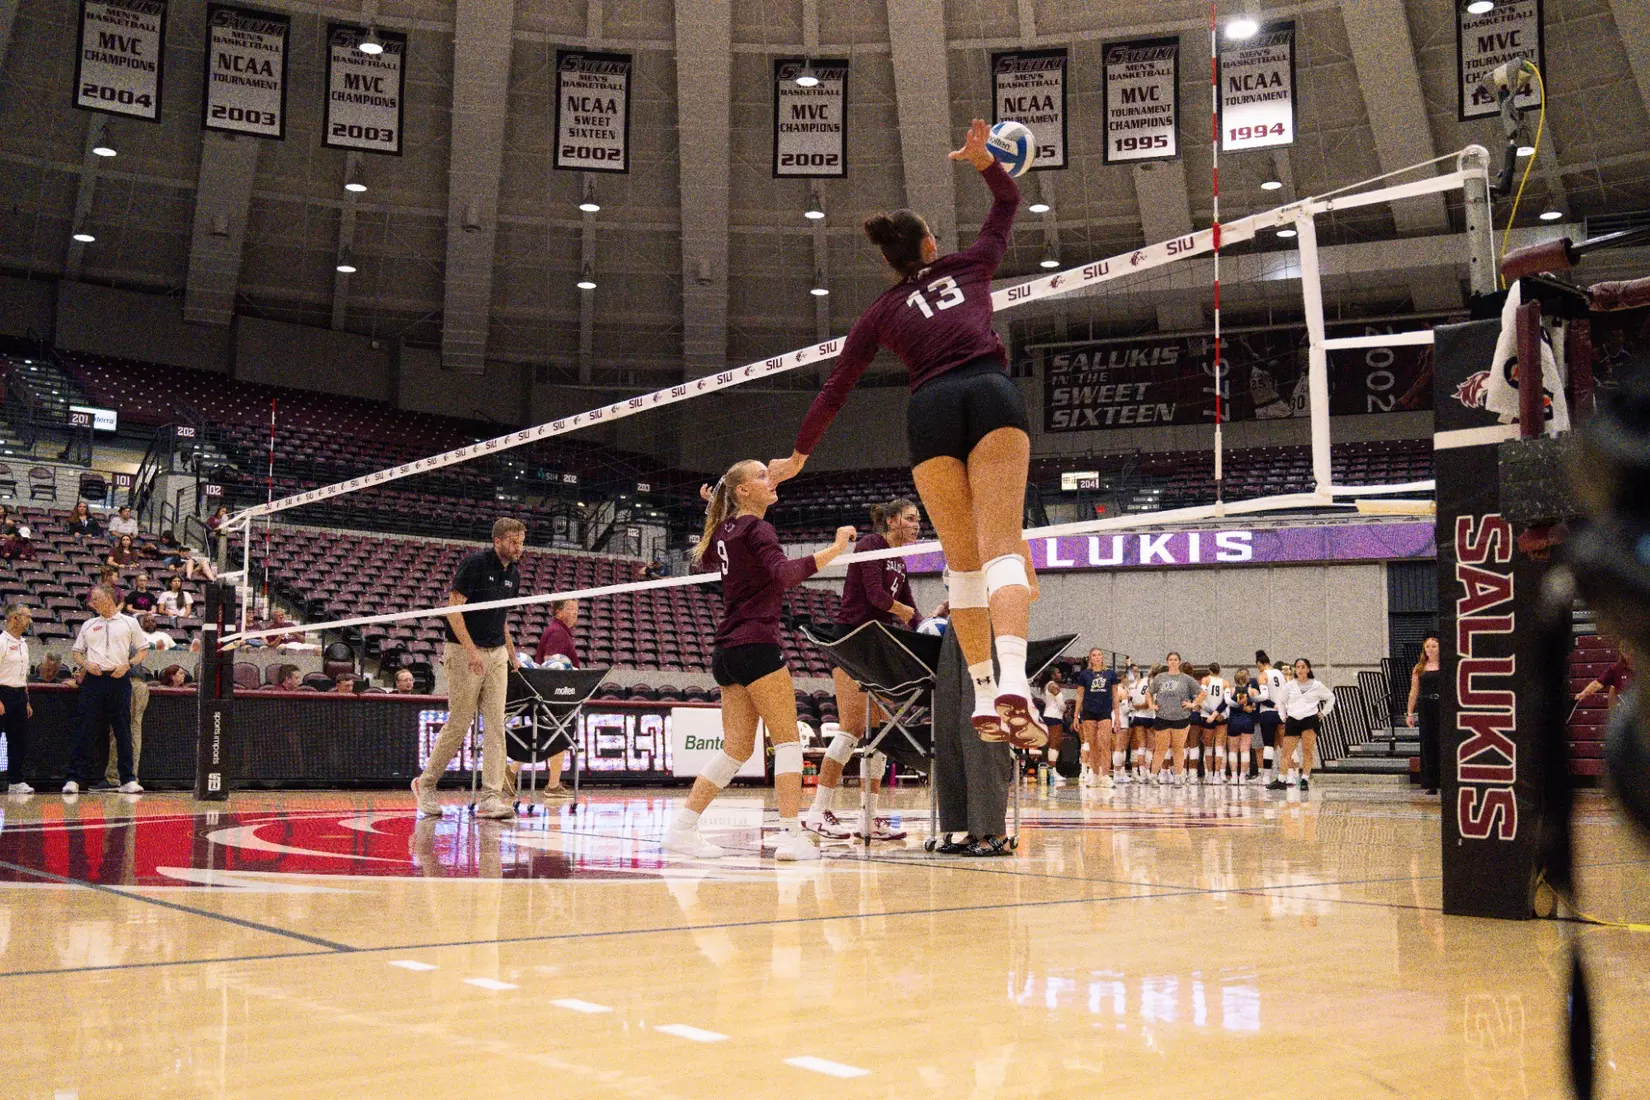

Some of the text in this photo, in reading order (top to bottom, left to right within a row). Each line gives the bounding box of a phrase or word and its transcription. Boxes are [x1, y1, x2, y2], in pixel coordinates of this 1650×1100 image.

[86, 12, 158, 33] BASKETBALL
[1463, 10, 1533, 30] BASKETBALL
[99, 32, 142, 55] MVC
[213, 36, 280, 52] BASKETBALL
[231, 31, 263, 42] MEN'S
[1477, 30, 1521, 53] MVC
[84, 50, 155, 72] CHAMPIONS
[1223, 54, 1288, 69] BASKETBALL
[1240, 49, 1270, 58] MEN'S
[1465, 49, 1536, 69] TOURNAMENT
[218, 53, 273, 77] NCAA
[333, 56, 397, 70] BASKETBALL
[1125, 63, 1154, 72] MEN'S
[212, 73, 277, 90] TOURNAMENT
[579, 74, 608, 83] MEN'S
[1014, 73, 1044, 81] MEN'S
[1109, 68, 1172, 80] BASKETBALL
[1229, 71, 1282, 93] NCAA
[344, 73, 384, 93] MVC
[562, 81, 623, 91] BASKETBALL
[998, 78, 1060, 89] BASKETBALL
[83, 83, 152, 108] 2004
[332, 91, 396, 108] CHAMPIONS
[1121, 86, 1159, 104] MVC
[1225, 90, 1288, 106] TOURNAMENT
[568, 96, 617, 114] NCAA
[792, 105, 828, 119] MVC
[1004, 95, 1054, 113] NCAA
[1110, 104, 1172, 117] TOURNAMENT
[212, 105, 276, 126] 2003
[574, 115, 611, 127] SWEET
[1109, 116, 1172, 131] CHAMPIONS
[333, 123, 393, 142] 2003
[569, 128, 616, 140] SIXTEEN
[780, 123, 840, 133] CHAMPIONS
[1229, 122, 1285, 141] 1994
[1115, 135, 1168, 151] 1995
[562, 145, 621, 161] 2002
[781, 153, 838, 166] 2002
[906, 275, 965, 318] 13
[456, 448, 466, 458] SIU
[486, 440, 497, 449] SIU
[518, 430, 530, 441] SIU
[553, 421, 565, 432] SIU
[589, 409, 602, 421] SIU
[628, 398, 643, 409] SIU
[672, 385, 686, 398] SIU
[717, 372, 733, 385] SIU
[766, 358, 783, 371] SIU
[819, 341, 837, 355] SIU
[1007, 285, 1031, 302] SIU
[1083, 262, 1109, 280] SIU
[1166, 236, 1195, 256] SIU
[1051, 346, 1180, 373] SALUKIS
[1052, 372, 1109, 385] IN THE
[1051, 382, 1152, 406] SWEET
[72, 414, 89, 423] 201
[1051, 403, 1176, 428] SIXTEEN
[177, 427, 195, 437] 202
[116, 475, 130, 486] 101
[1080, 480, 1095, 489] 204
[206, 485, 221, 495] 102
[1047, 531, 1253, 567] LUKIS
[717, 540, 729, 575] 9
[1455, 513, 1518, 841] SALUKIS
[554, 686, 576, 695] molten
[1210, 685, 1220, 697] 19
[213, 711, 221, 734] sports
[212, 735, 221, 764] imports
